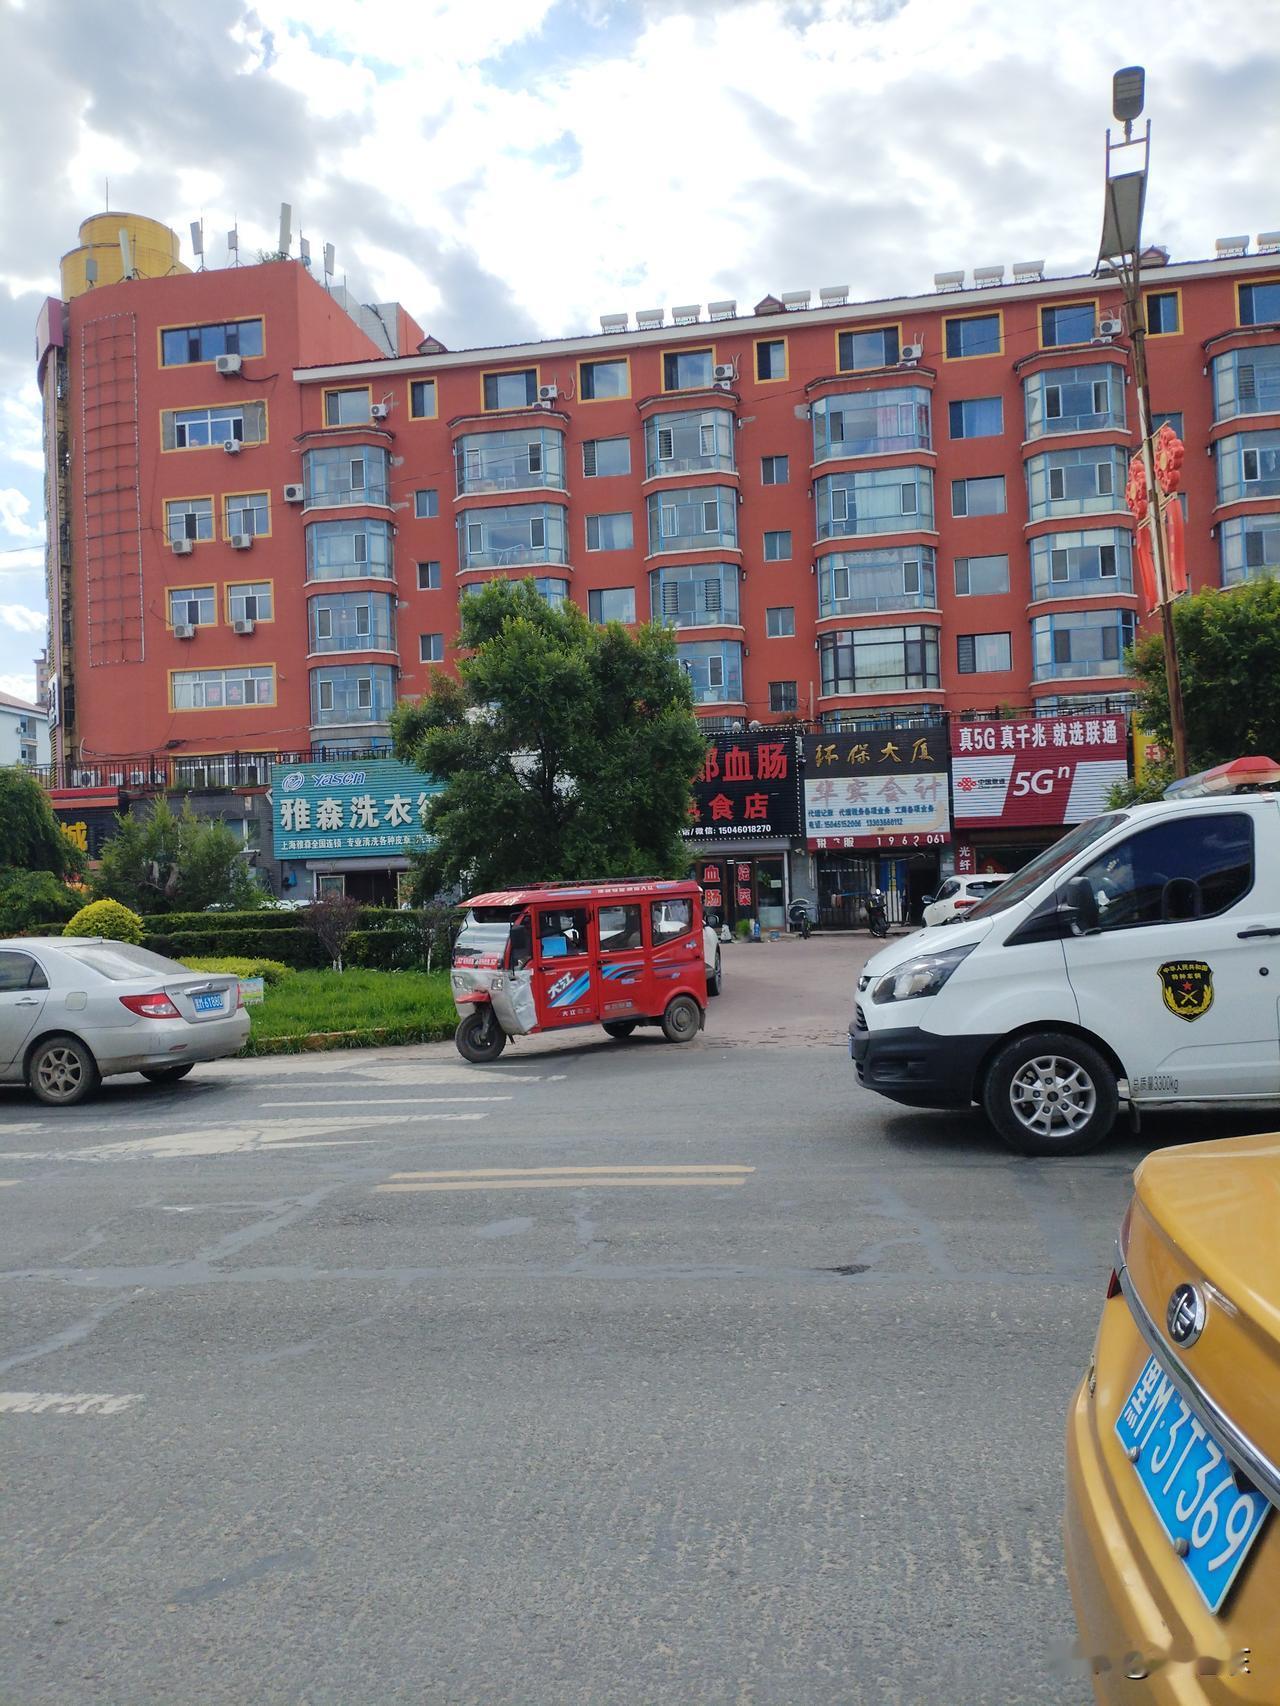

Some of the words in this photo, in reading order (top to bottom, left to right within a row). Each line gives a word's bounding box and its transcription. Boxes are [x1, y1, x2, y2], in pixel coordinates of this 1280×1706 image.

[959, 727, 996, 751] 真5G
[1000, 723, 1047, 750] 真千兆
[1053, 719, 1118, 747] 就选联通
[815, 737, 935, 768] 环保大厦
[718, 824, 772, 835] 15046018270
[958, 846, 971, 871] 光纤
[703, 864, 721, 907] 血肠
[1162, 963, 1209, 974] 中华人民共和国
[547, 971, 575, 1000] 大江
